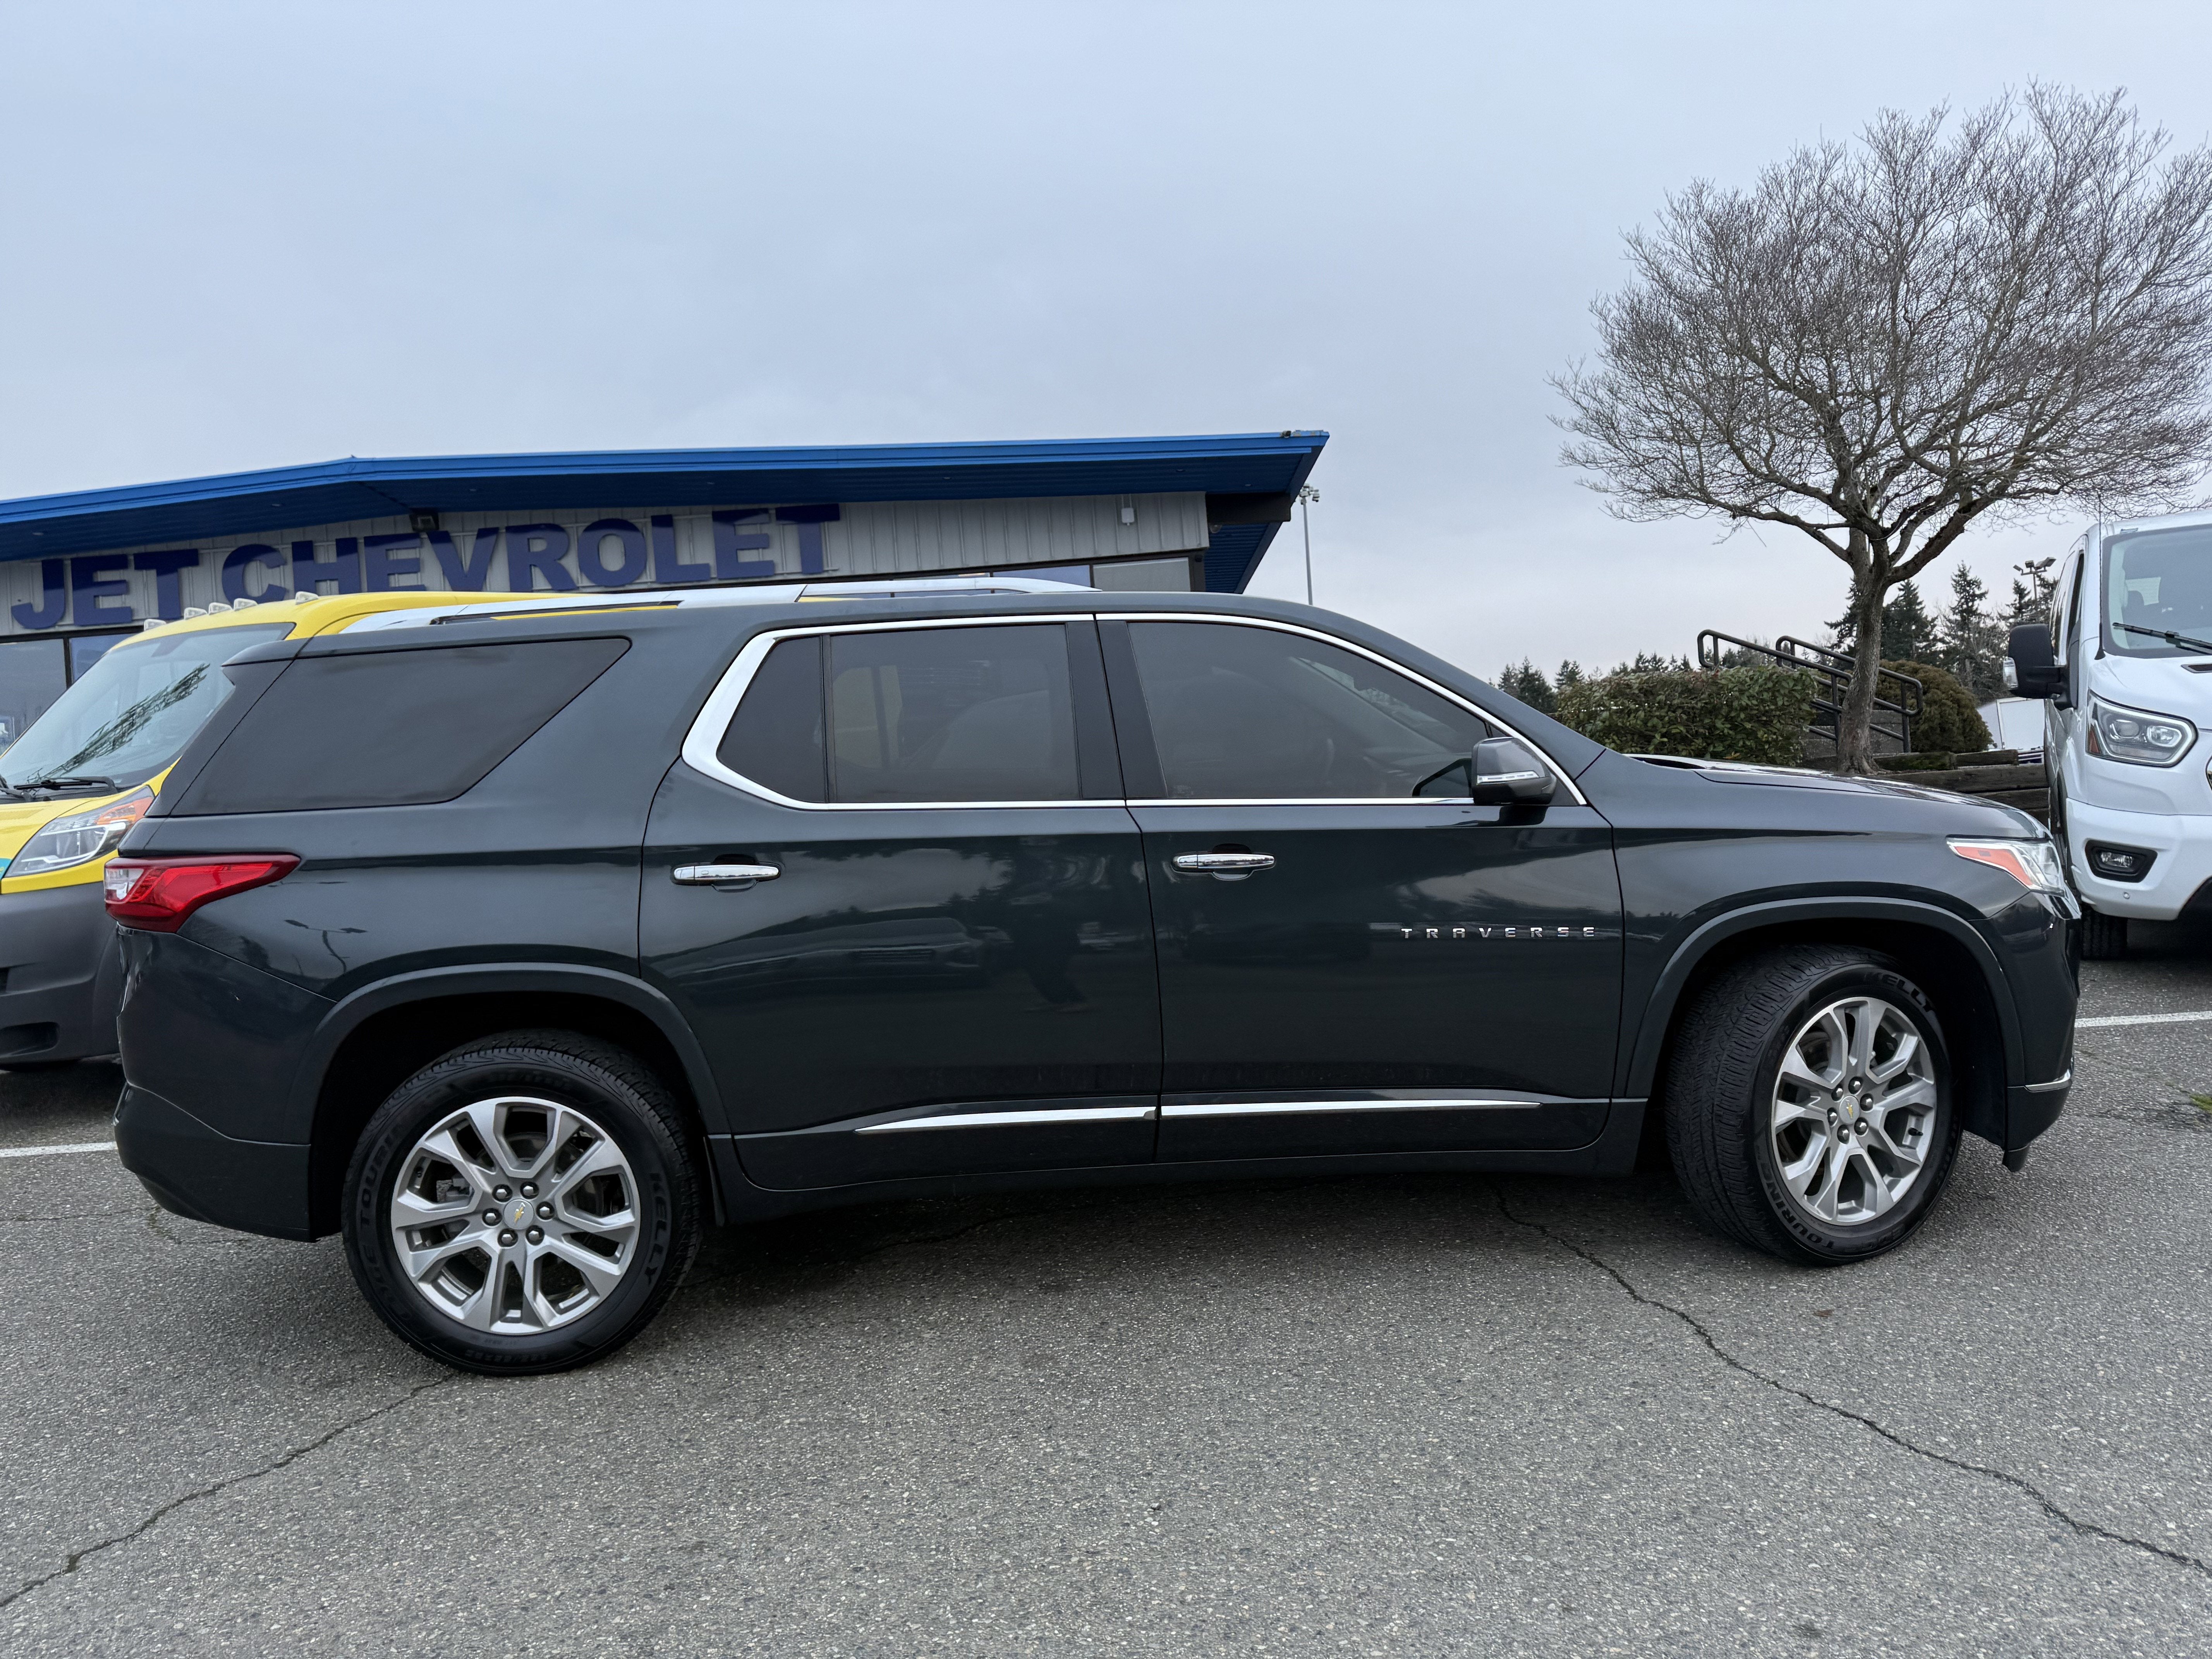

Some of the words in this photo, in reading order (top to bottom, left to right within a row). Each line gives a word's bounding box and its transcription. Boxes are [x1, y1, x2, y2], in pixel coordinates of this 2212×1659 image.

[11, 548, 199, 629] JET
[222, 503, 840, 603] CHEVROLET
[1401, 927, 1594, 939] TRAVERSE
[644, 1173, 667, 1286] KELLY
